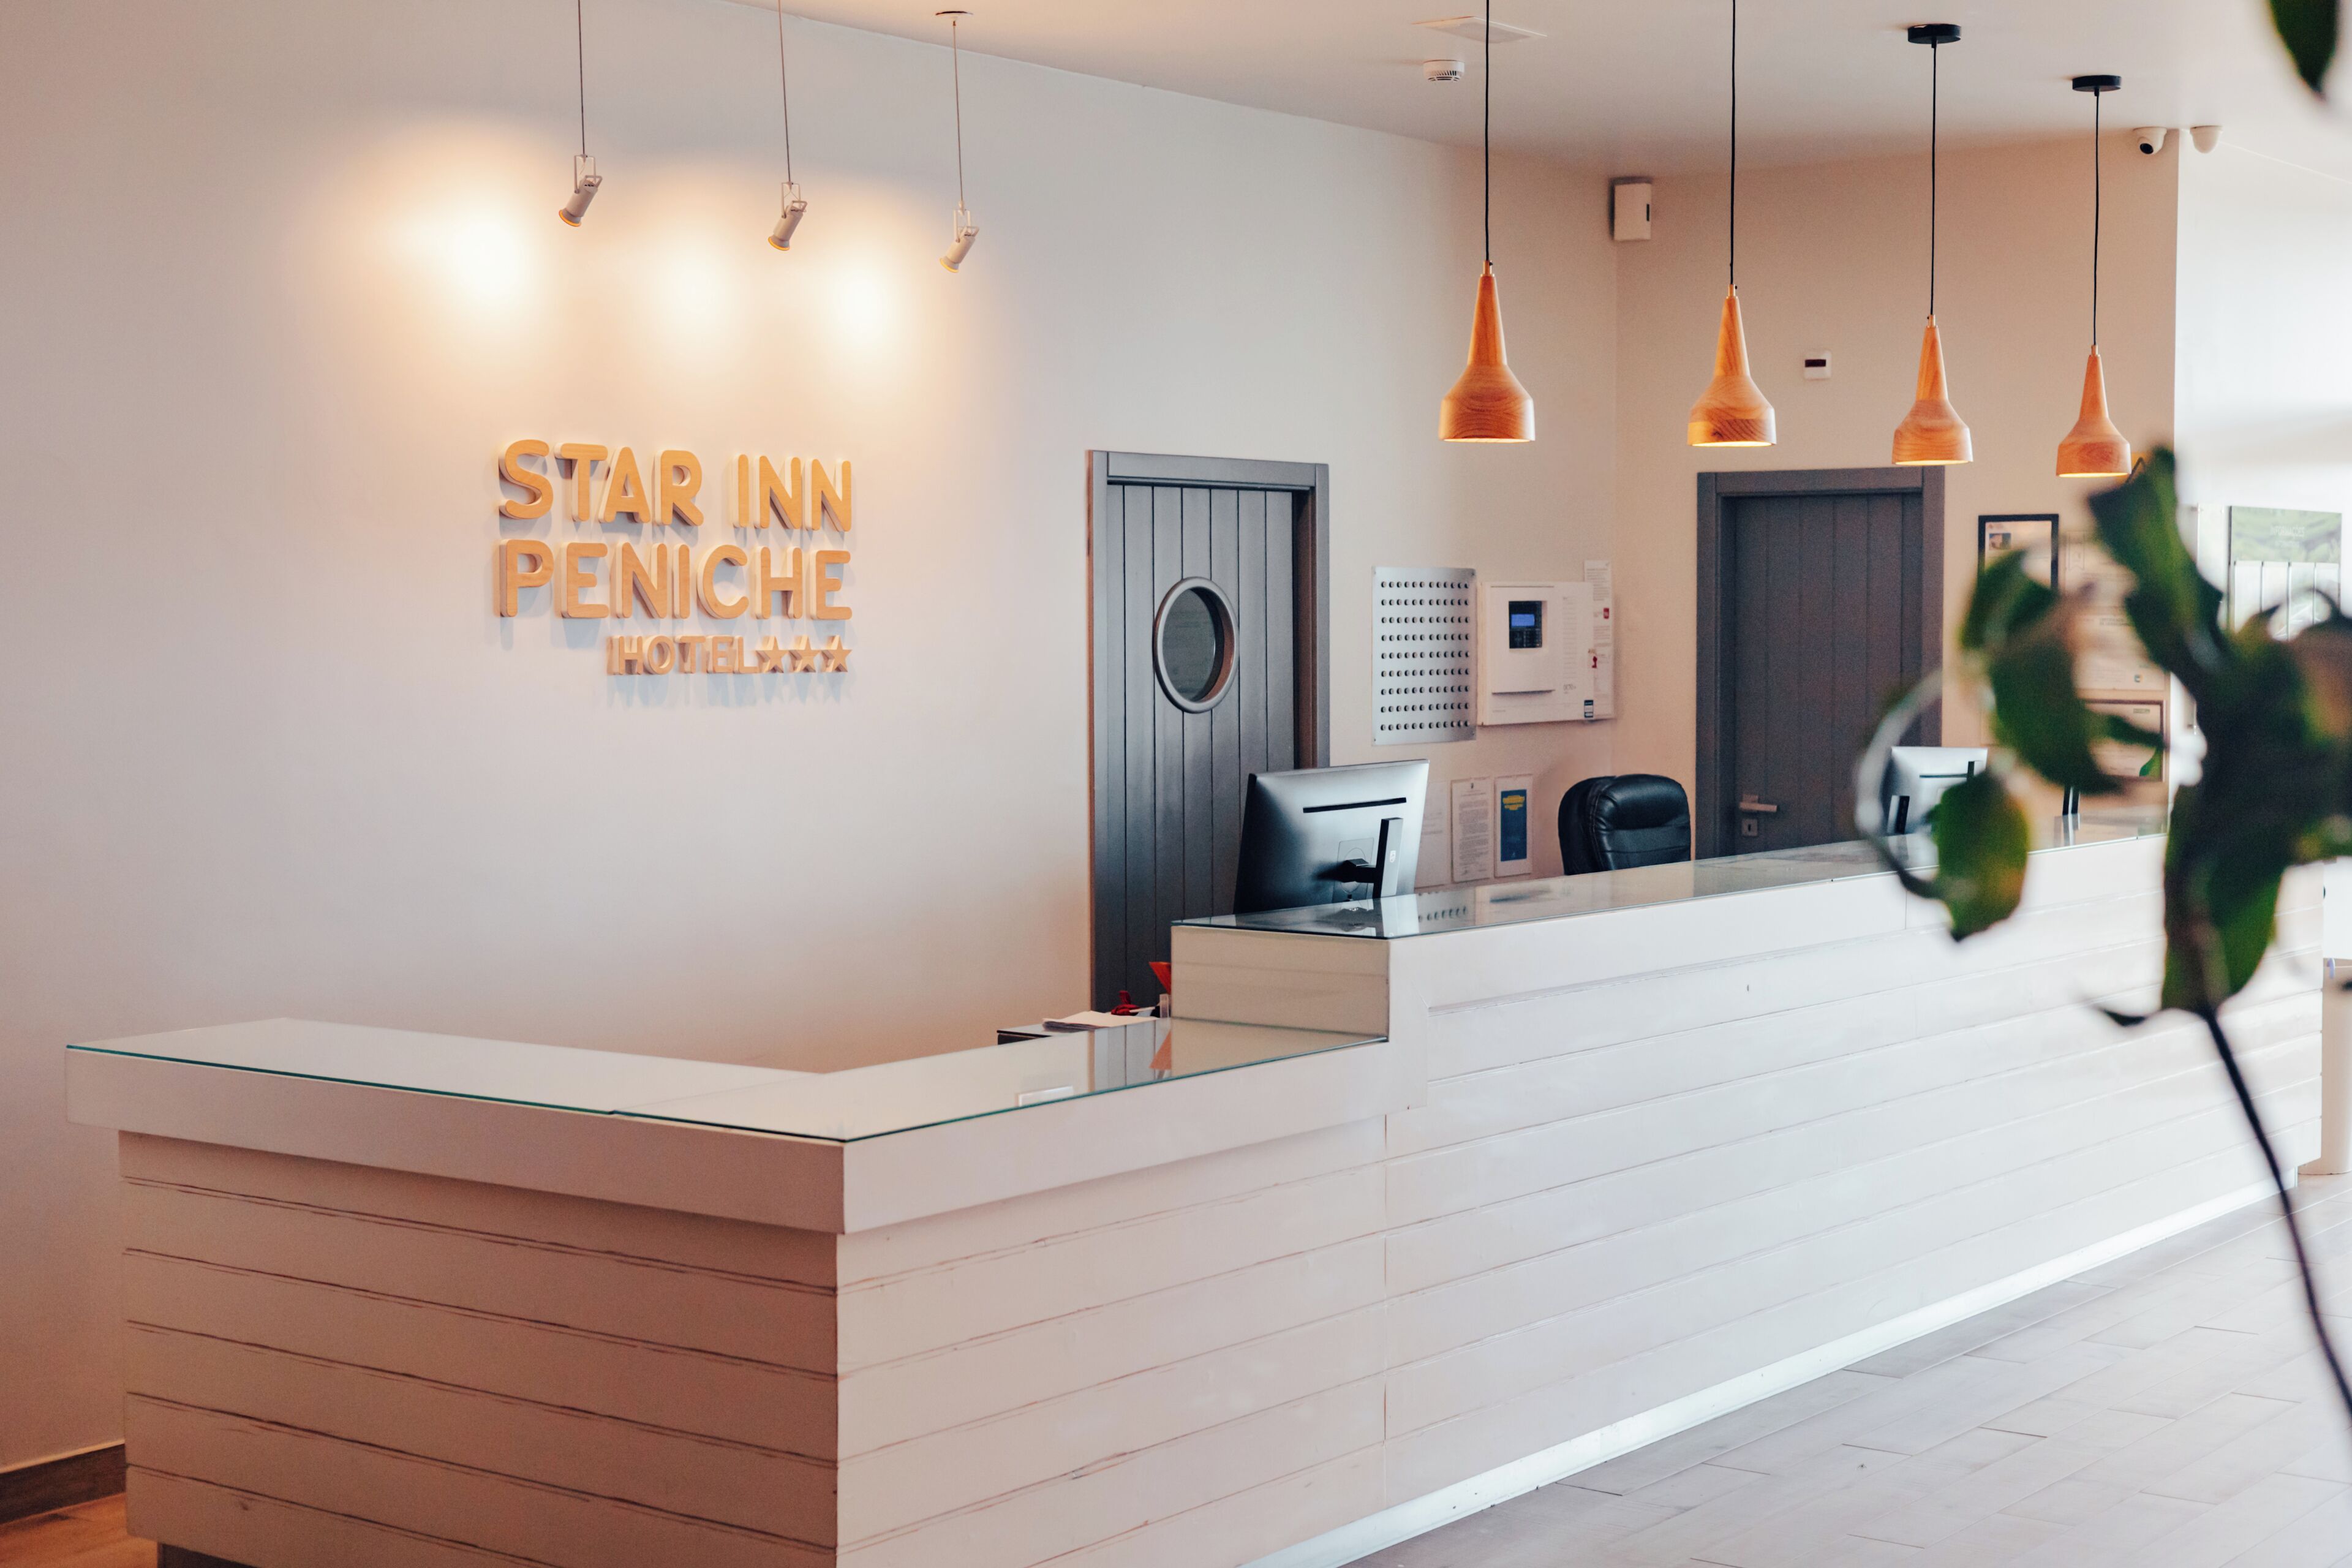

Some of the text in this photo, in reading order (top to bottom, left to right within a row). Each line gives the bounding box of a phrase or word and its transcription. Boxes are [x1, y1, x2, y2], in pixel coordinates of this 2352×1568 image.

[499, 439, 851, 532] STAR INN
[499, 539, 853, 620] PENICHE
[608, 635, 758, 675] HOTEL
